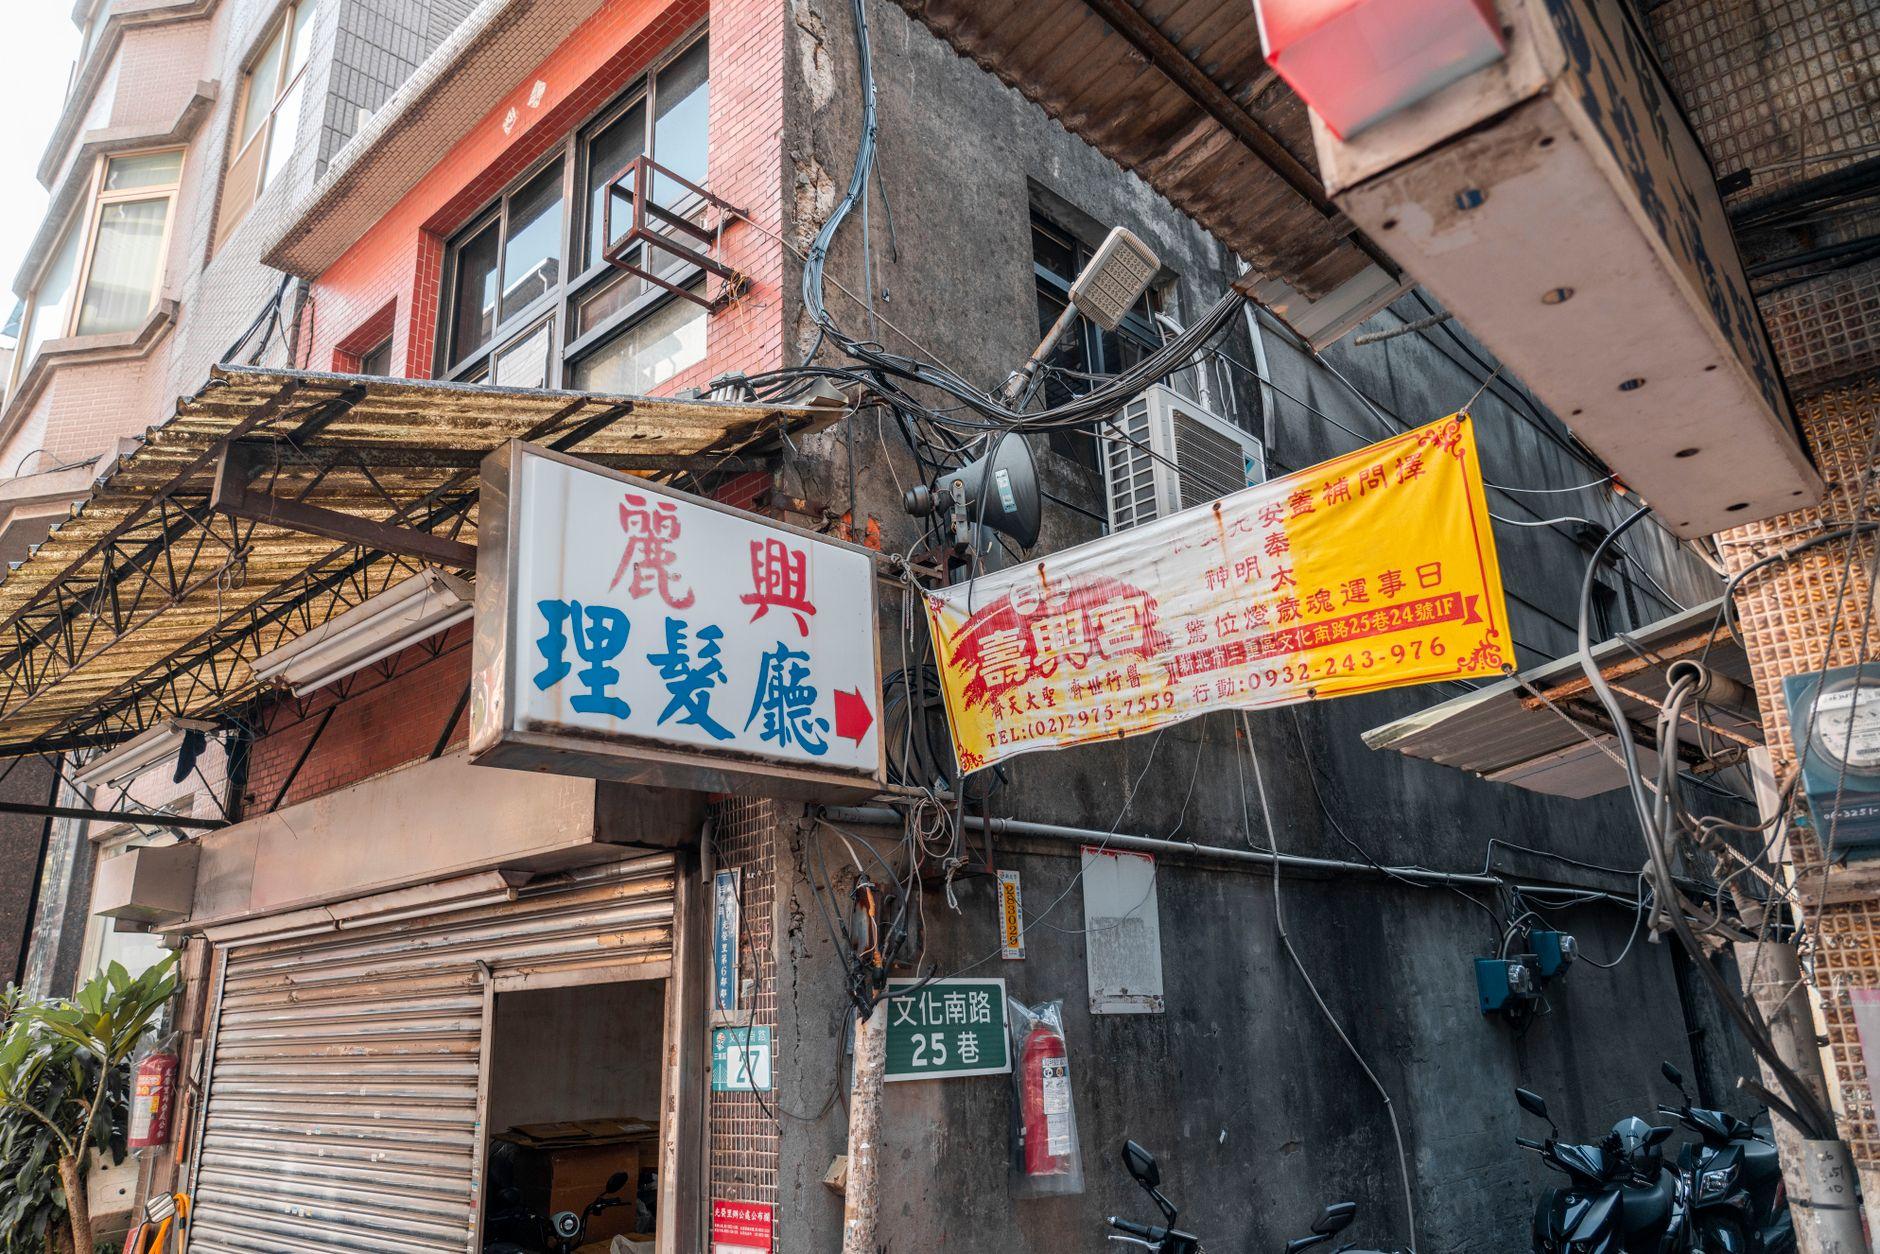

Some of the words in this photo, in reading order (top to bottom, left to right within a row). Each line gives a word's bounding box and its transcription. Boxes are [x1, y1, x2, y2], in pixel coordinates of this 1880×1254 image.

[978, 596, 1145, 687] 壽興宮
[1178, 598, 1454, 672] 新北市三重區文化南路25巷24號1F
[533, 599, 830, 756] 理髮廳
[987, 691, 1175, 748] TEL:(02)2975-7559
[892, 991, 991, 1027] 文化南路
[736, 1050, 761, 1083] 27
